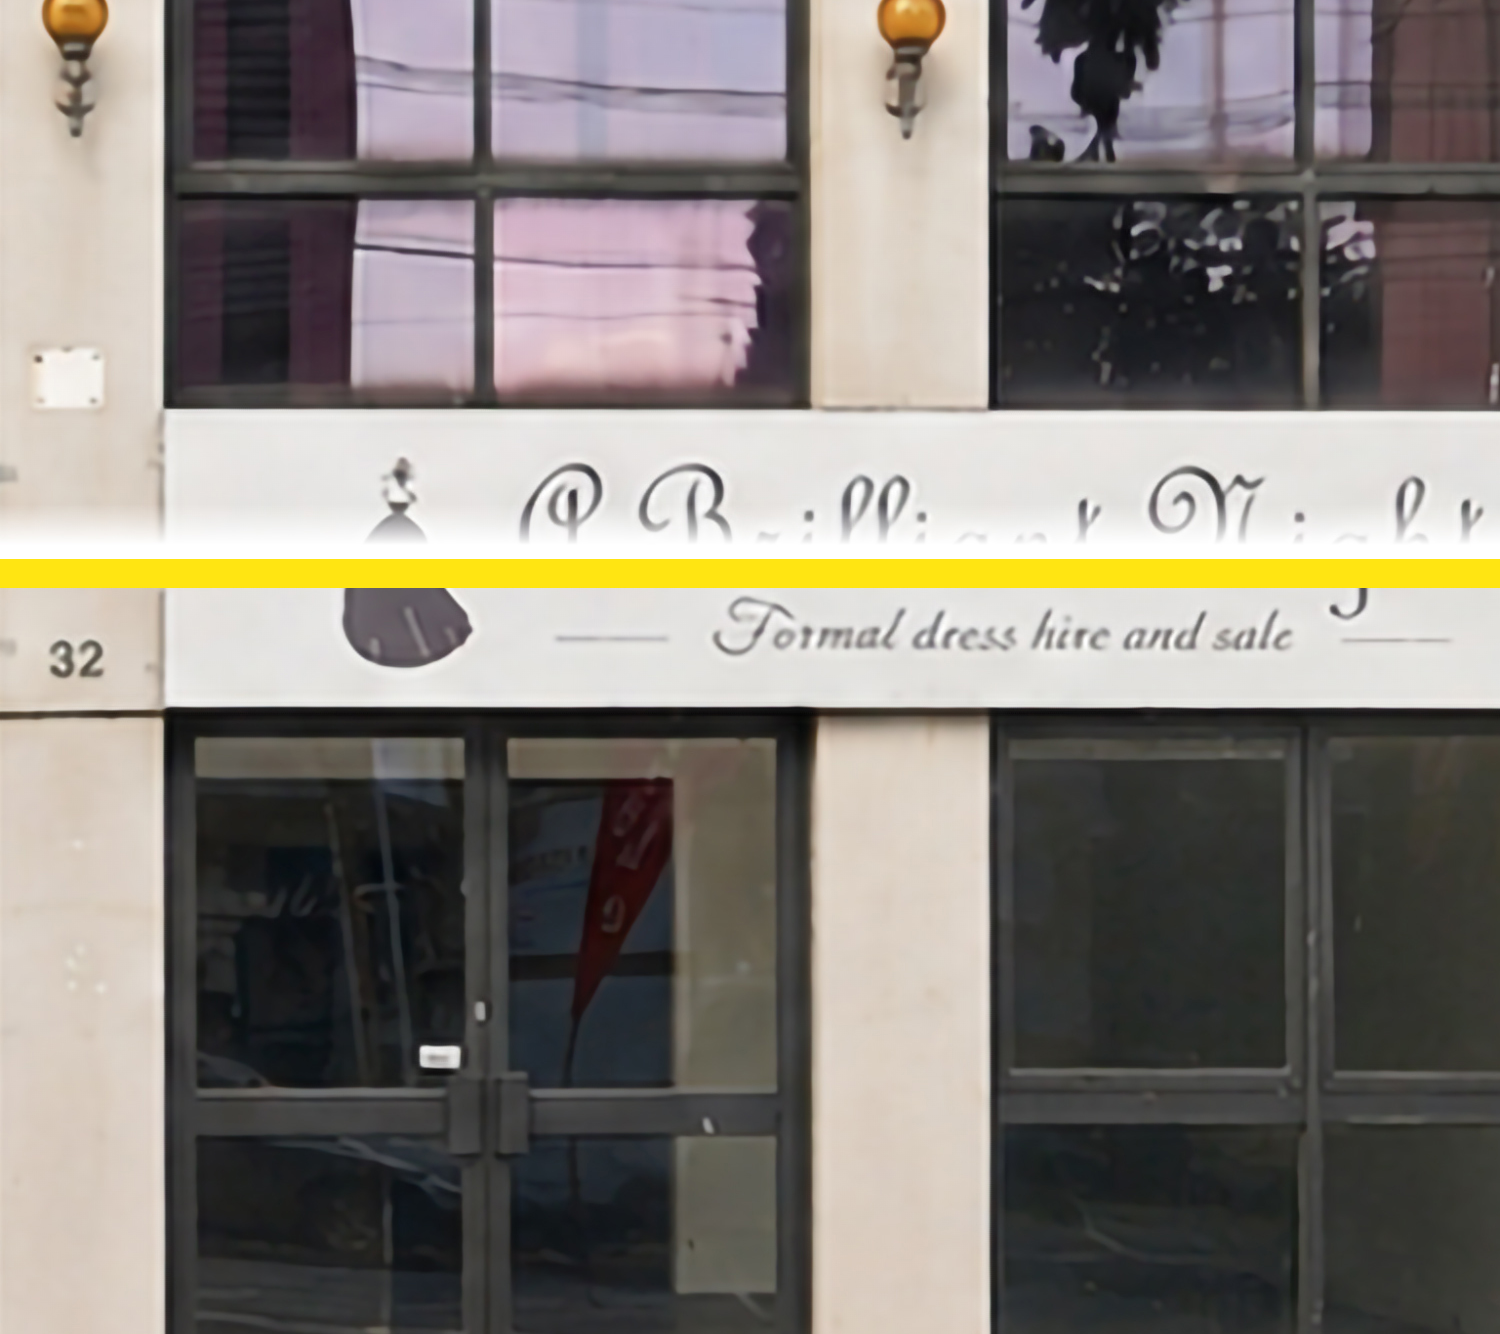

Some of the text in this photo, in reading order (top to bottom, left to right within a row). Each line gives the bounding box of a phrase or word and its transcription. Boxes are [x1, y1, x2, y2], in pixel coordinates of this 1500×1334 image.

[711, 595, 1294, 657] Formal dress hire and sale
[49, 639, 105, 679] 32
